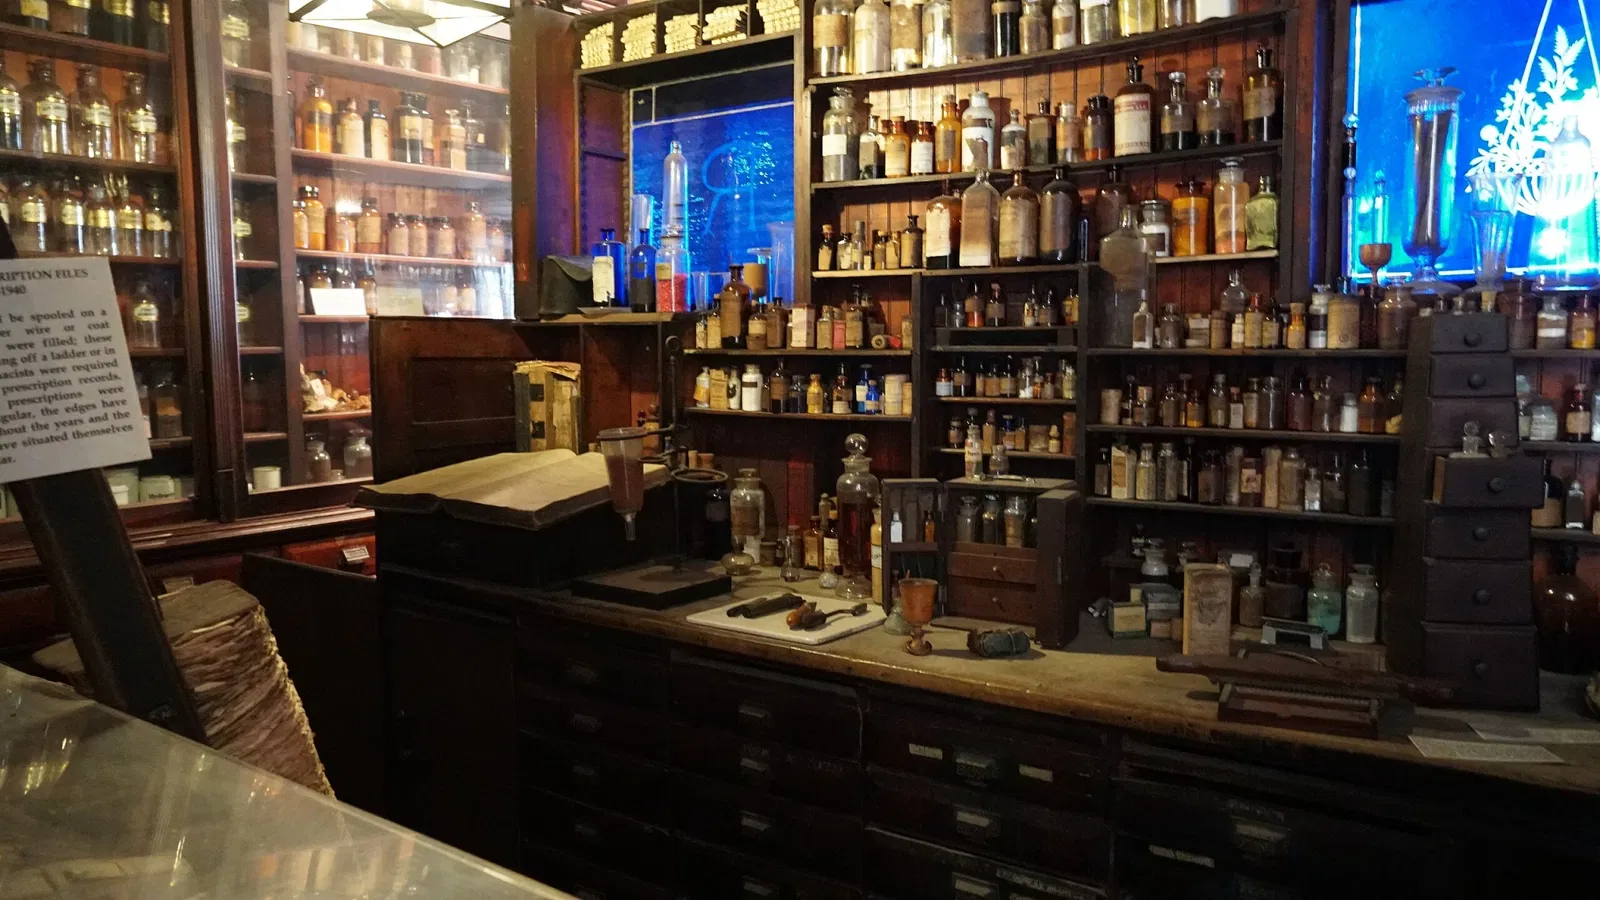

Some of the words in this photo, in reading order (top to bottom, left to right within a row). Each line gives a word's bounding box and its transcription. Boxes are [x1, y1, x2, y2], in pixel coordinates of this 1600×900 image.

[55, 268, 89, 279] FILES
[9, 312, 24, 322] be
[30, 309, 75, 323] spooled
[81, 309, 95, 317] on
[25, 326, 51, 335] wire
[87, 321, 110, 330] coat
[6, 342, 35, 350] were
[84, 334, 112, 343] these
[0, 357, 18, 367] ng
[20, 352, 37, 363] off
[51, 349, 86, 360] ladder
[90, 349, 101, 357] or
[104, 346, 116, 355] in
[0, 369, 35, 379] acists
[39, 366, 67, 375] were
[72, 358, 118, 372] required
[2, 378, 72, 396] prescription
[78, 372, 121, 384] records.
[8, 391, 83, 410] prescriptions
[98, 386, 124, 395] were
[41, 406, 59, 416] the
[64, 403, 97, 415] edges
[101, 398, 128, 409] have
[31, 421, 49, 431] the
[54, 418, 84, 431] years
[88, 412, 109, 423] and
[112, 410, 130, 420] the
[22, 432, 68, 447] situated
[72, 423, 134, 440] themselves
[0, 456, 16, 465] ar.
